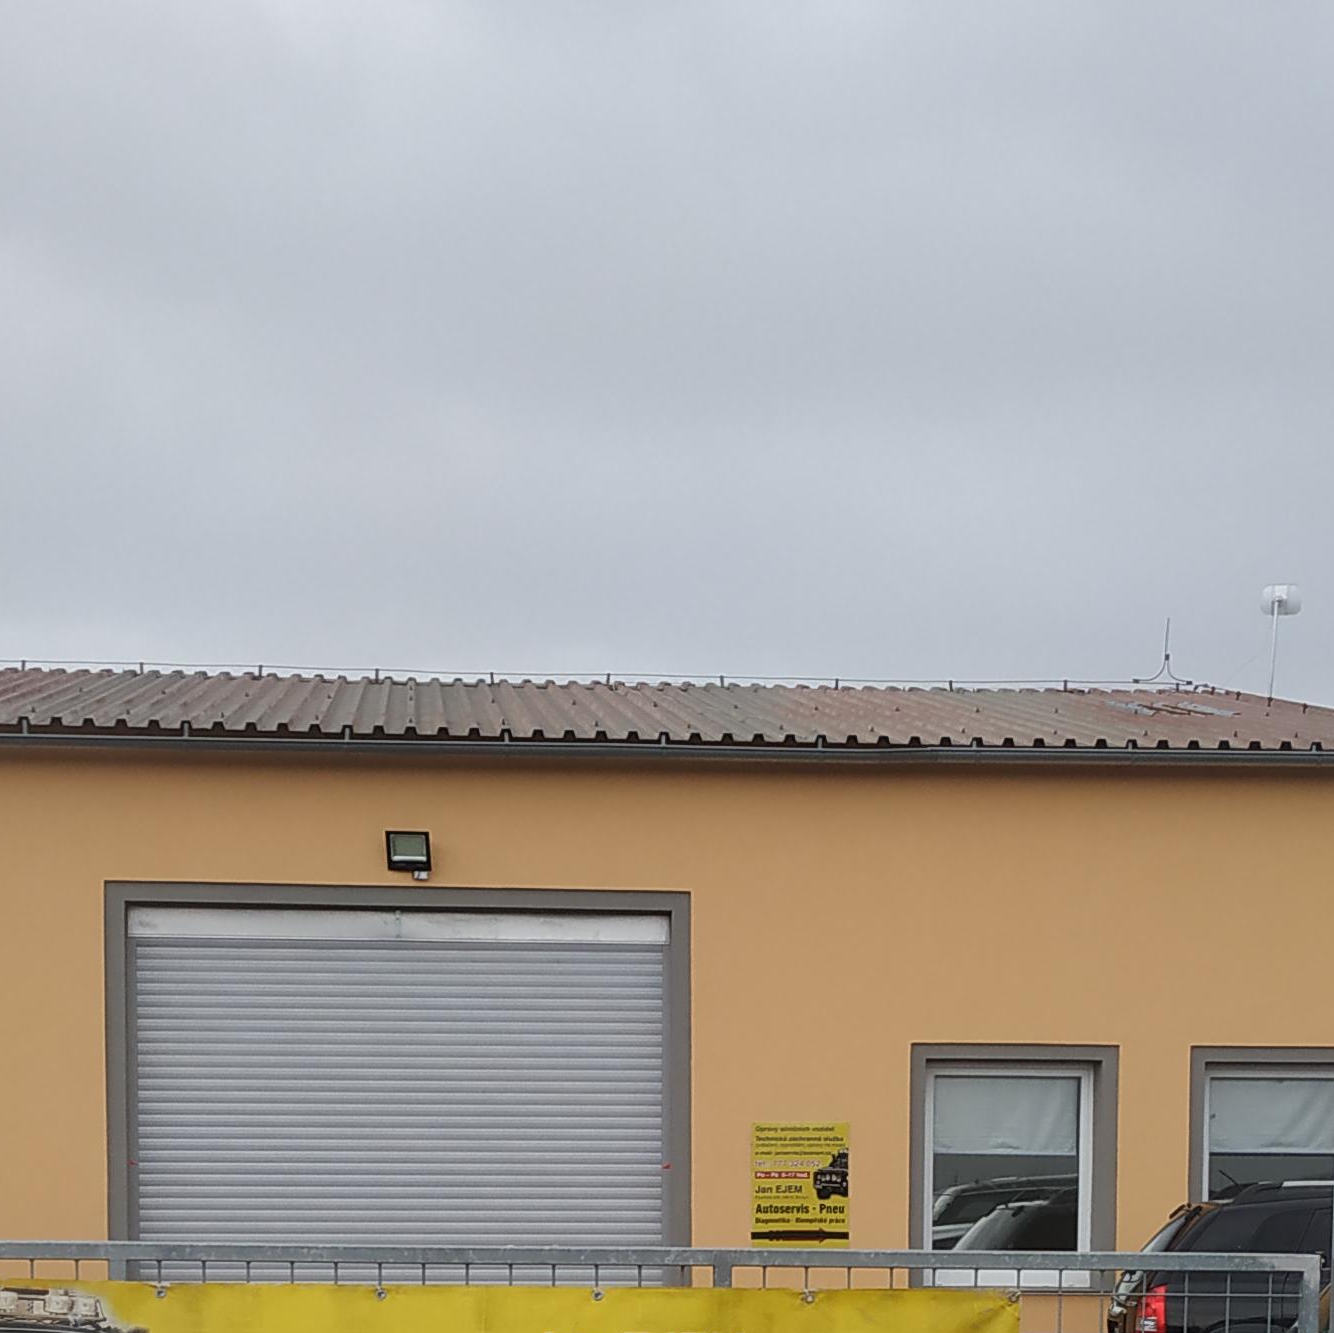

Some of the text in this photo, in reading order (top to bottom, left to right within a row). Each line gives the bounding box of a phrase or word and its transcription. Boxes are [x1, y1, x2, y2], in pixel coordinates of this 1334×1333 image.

[755, 1185, 803, 1194] Jan EJEM
[755, 1204, 810, 1214] Autoservis
[819, 1204, 845, 1214] Pneu
